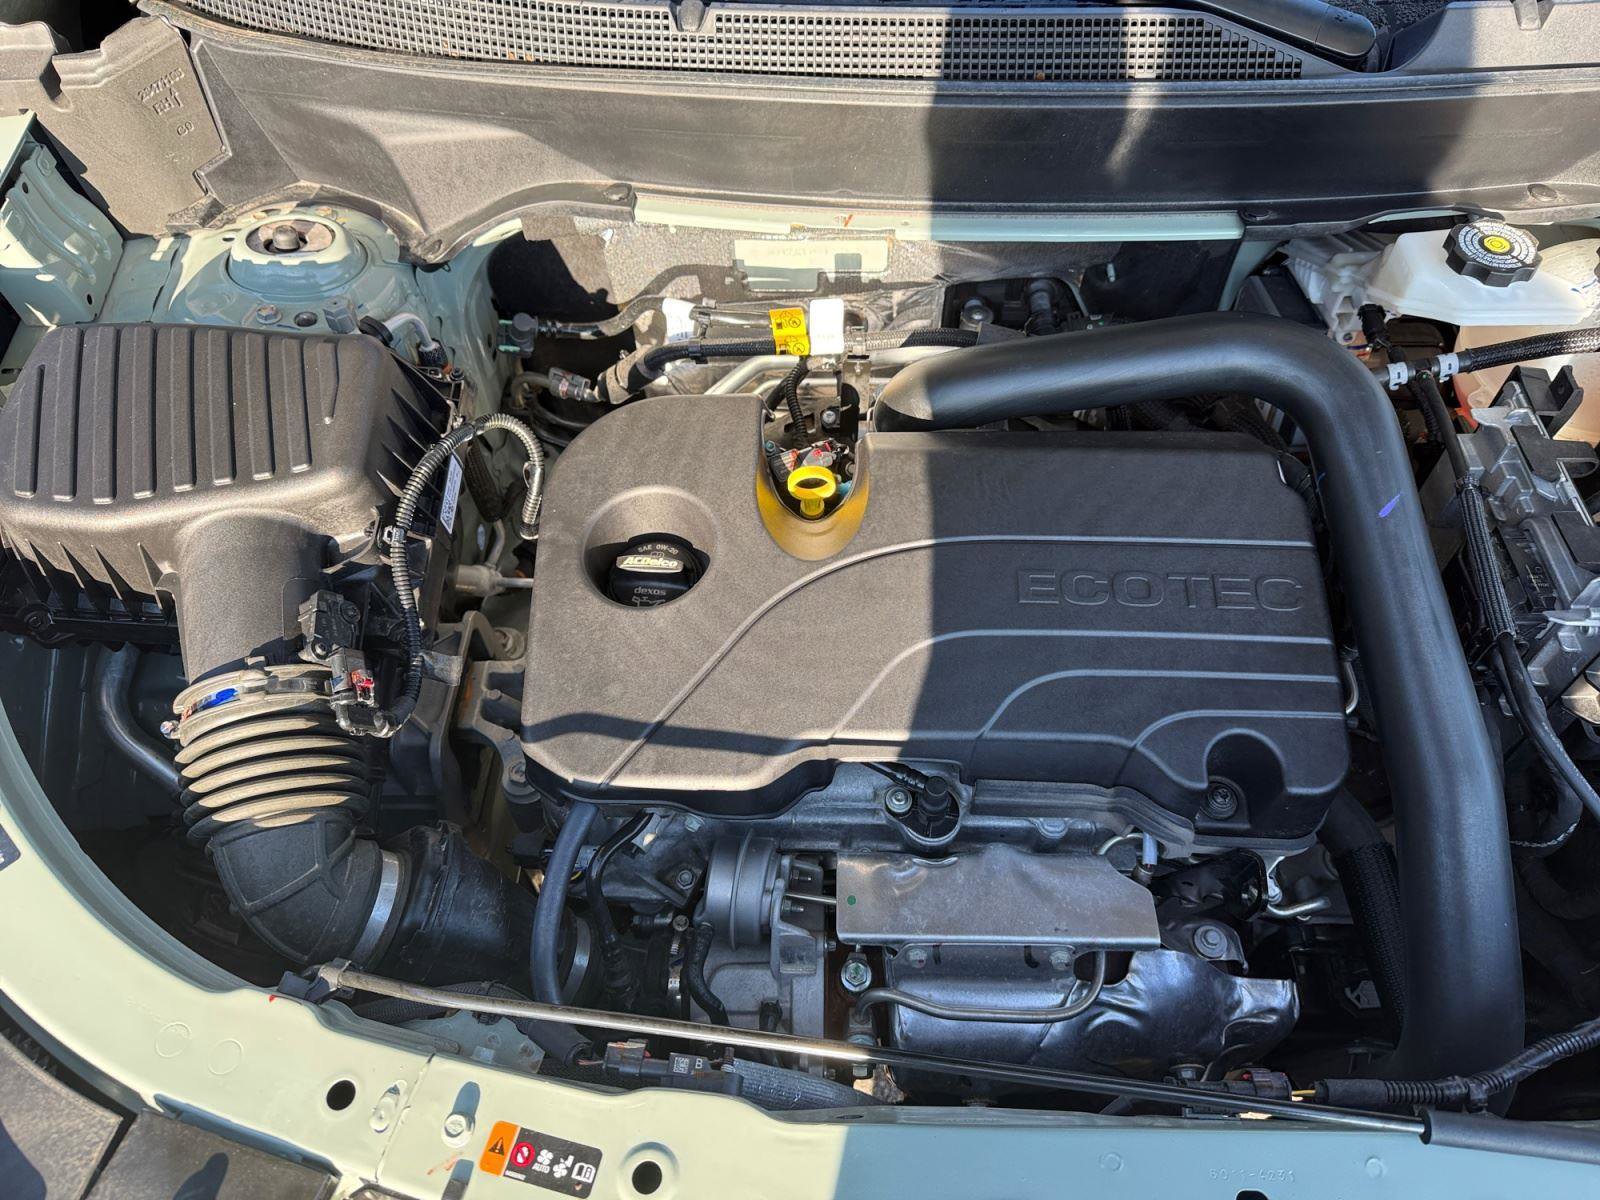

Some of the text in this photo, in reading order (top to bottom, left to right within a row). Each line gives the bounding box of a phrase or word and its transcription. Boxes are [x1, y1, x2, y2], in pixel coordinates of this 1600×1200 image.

[638, 544, 679, 555] SAE 0W-20
[621, 556, 679, 568] ACDelco
[633, 586, 667, 596] dexos
[1017, 569, 1303, 612] ECOTEC
[695, 1058, 703, 1069] B
